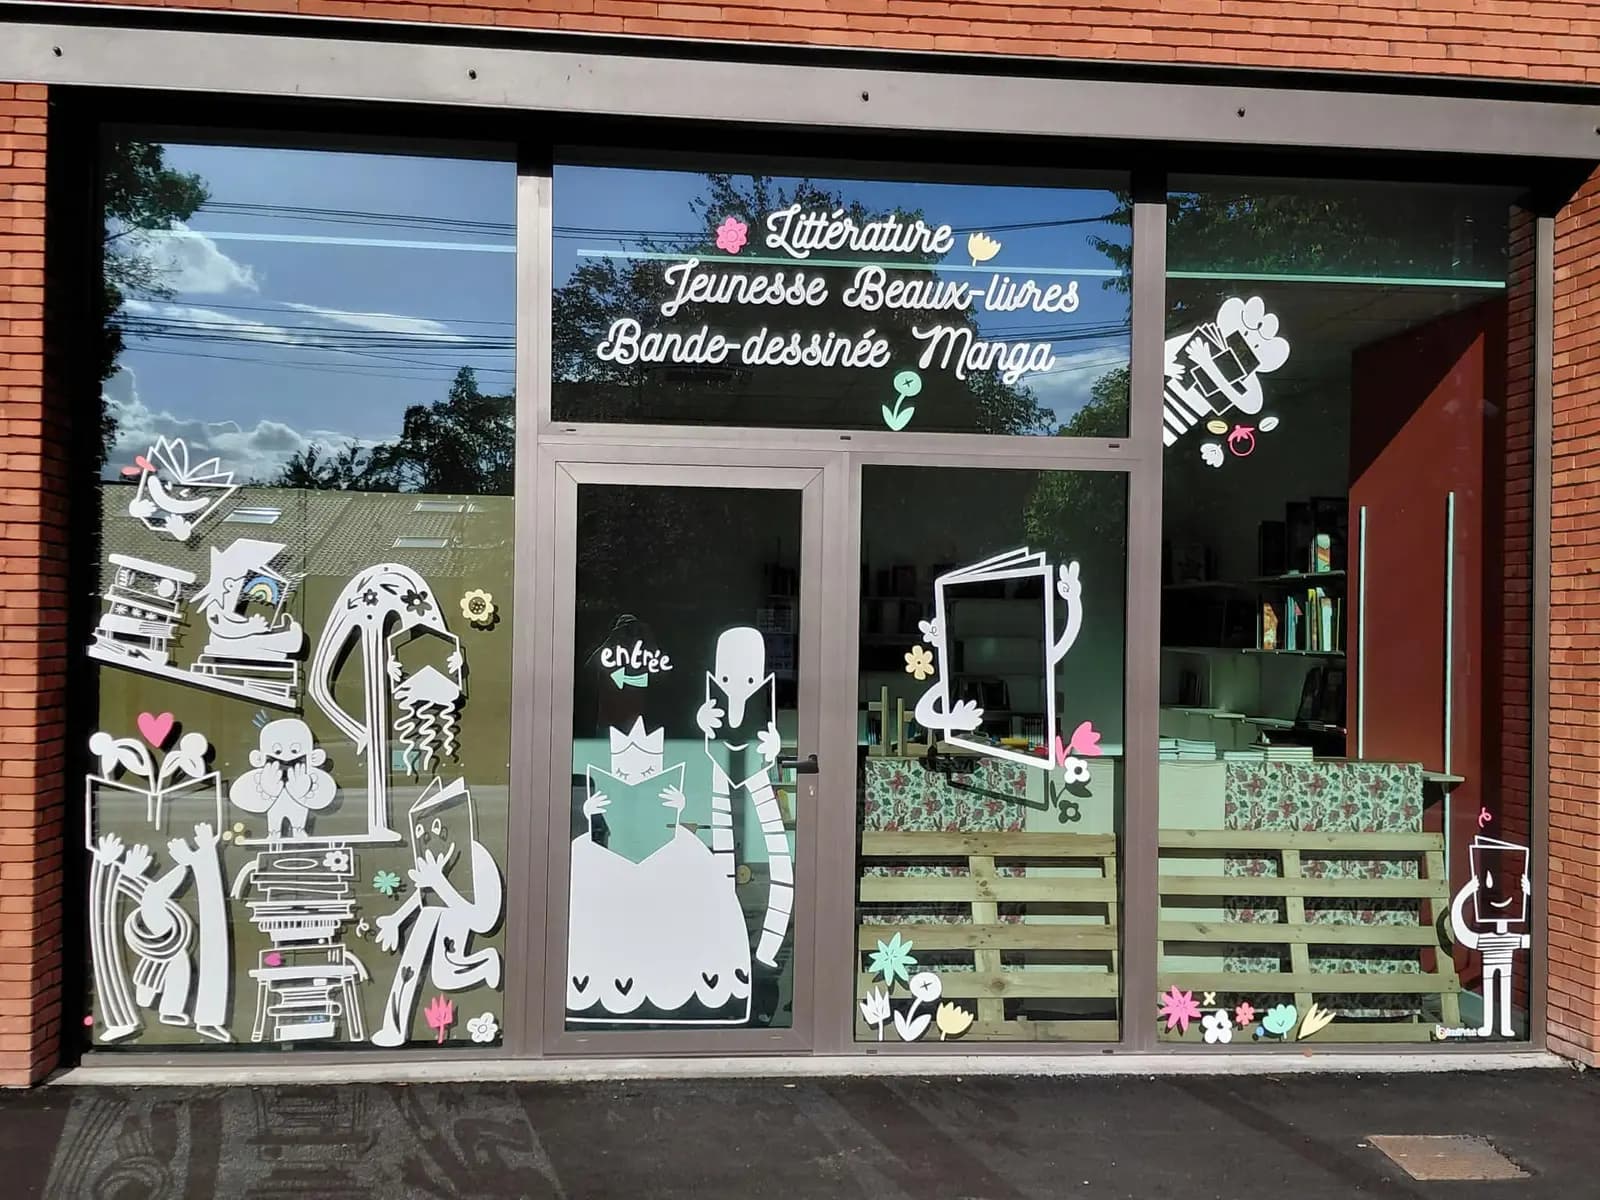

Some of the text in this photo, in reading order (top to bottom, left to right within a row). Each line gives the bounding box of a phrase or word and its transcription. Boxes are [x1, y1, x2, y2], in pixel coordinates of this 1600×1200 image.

[766, 204, 954, 257] Littérature
[661, 258, 1079, 316] Jeunesse Beaux-livres
[597, 319, 1056, 385] Bande-dessinée Manga
[601, 640, 673, 673] entrée
